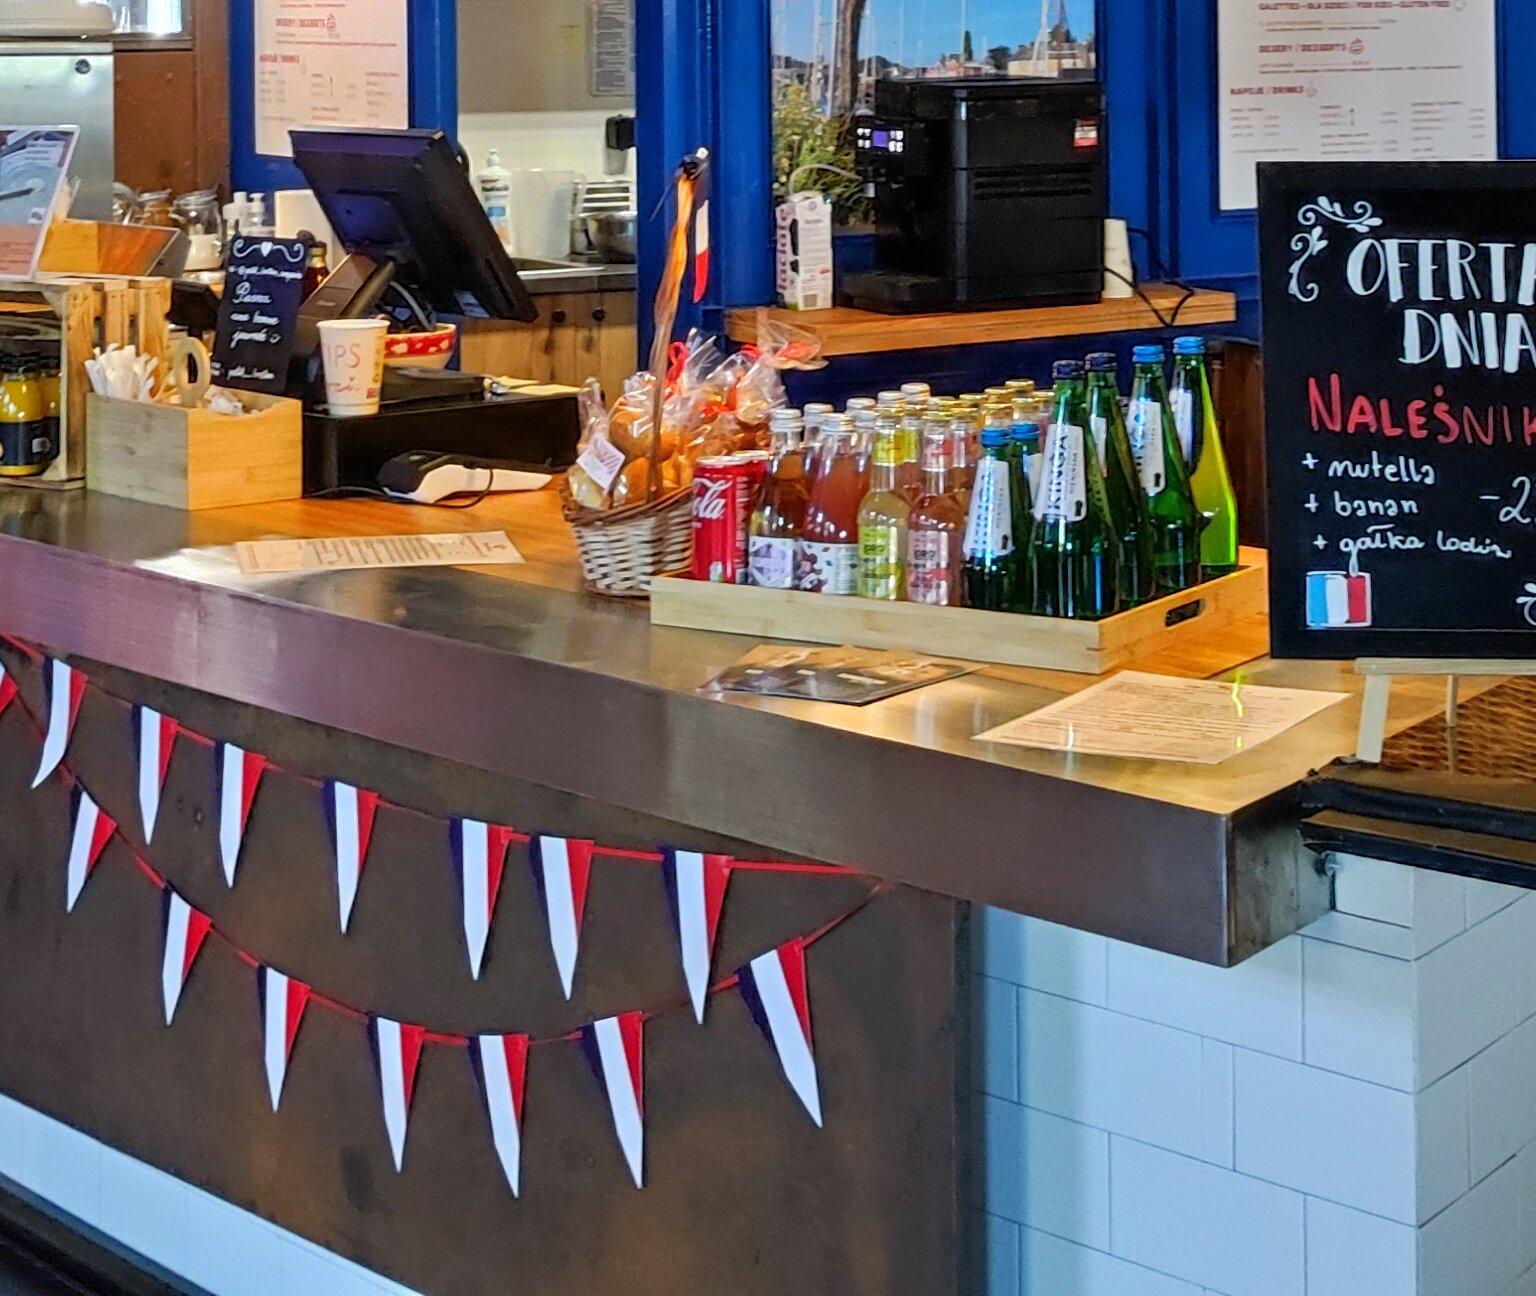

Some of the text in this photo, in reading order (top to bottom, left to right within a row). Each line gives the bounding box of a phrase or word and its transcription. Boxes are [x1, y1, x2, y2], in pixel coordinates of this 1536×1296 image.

[326, 343, 362, 369] IPS
[1327, 450, 1437, 486] nutella
[1333, 490, 1419, 517] banan
